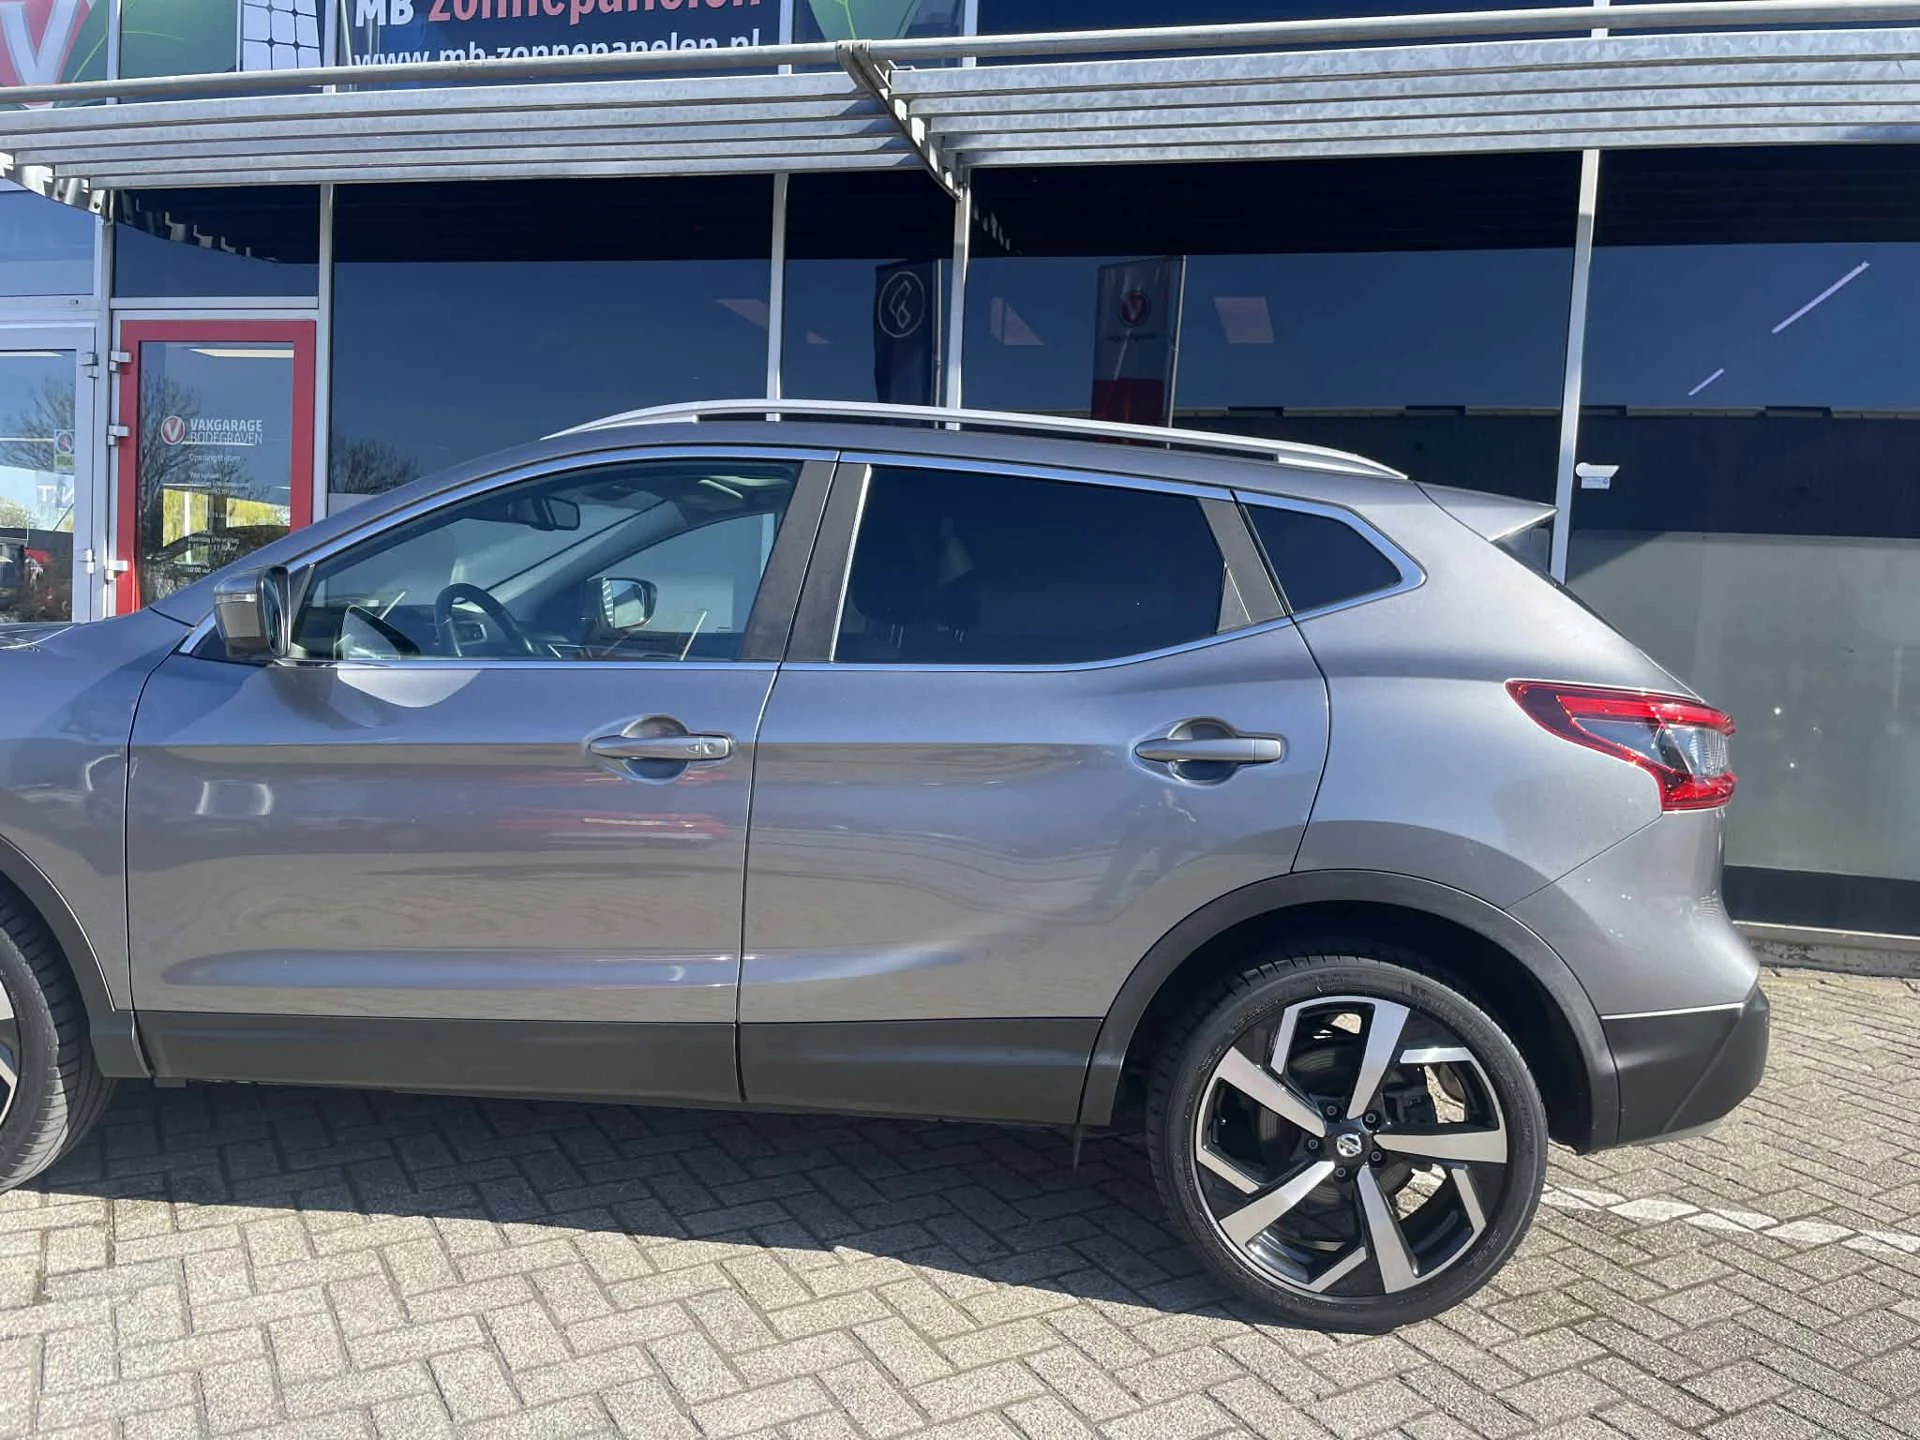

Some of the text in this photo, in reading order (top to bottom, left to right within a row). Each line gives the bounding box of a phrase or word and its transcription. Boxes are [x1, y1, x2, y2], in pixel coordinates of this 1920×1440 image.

[354, 0, 761, 27] MB zonnep
[354, 28, 760, 65] wwwmb-zonneanelennl
[190, 419, 263, 432] VAKGARAGE
[190, 431, 263, 447] BODEGRAVEN
